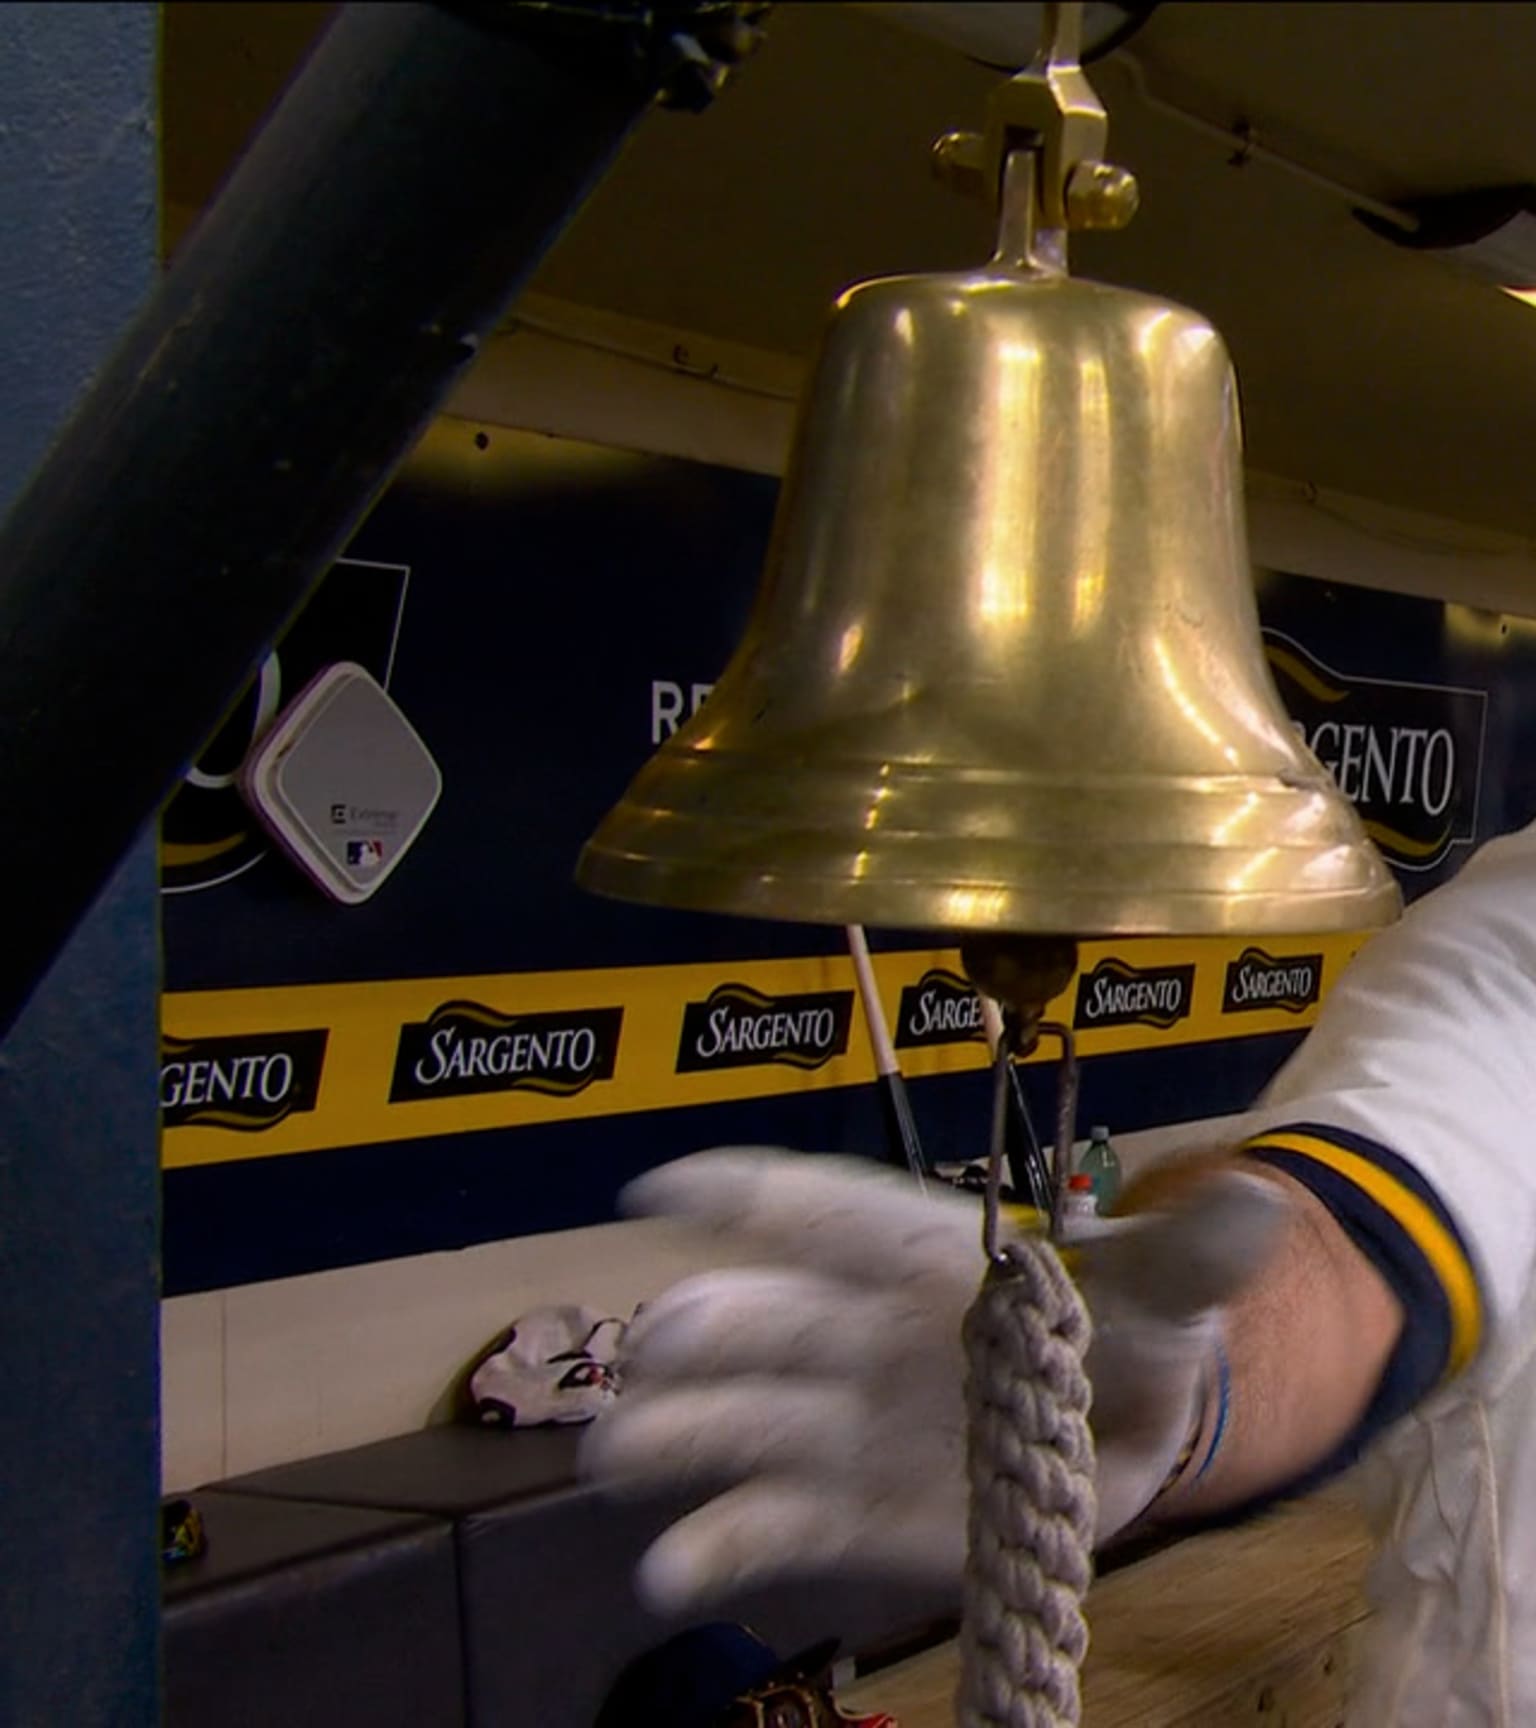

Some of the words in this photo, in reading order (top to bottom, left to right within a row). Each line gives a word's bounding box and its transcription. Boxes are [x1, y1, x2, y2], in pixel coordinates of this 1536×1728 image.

[1292, 719, 1454, 816] GENTO
[1086, 978, 1182, 1018] SARGENTO
[1233, 961, 1311, 1002] SARGENTO
[697, 1005, 834, 1058] SARGENTO
[909, 989, 985, 1036] SARGE
[415, 1025, 595, 1086] SARGENTO
